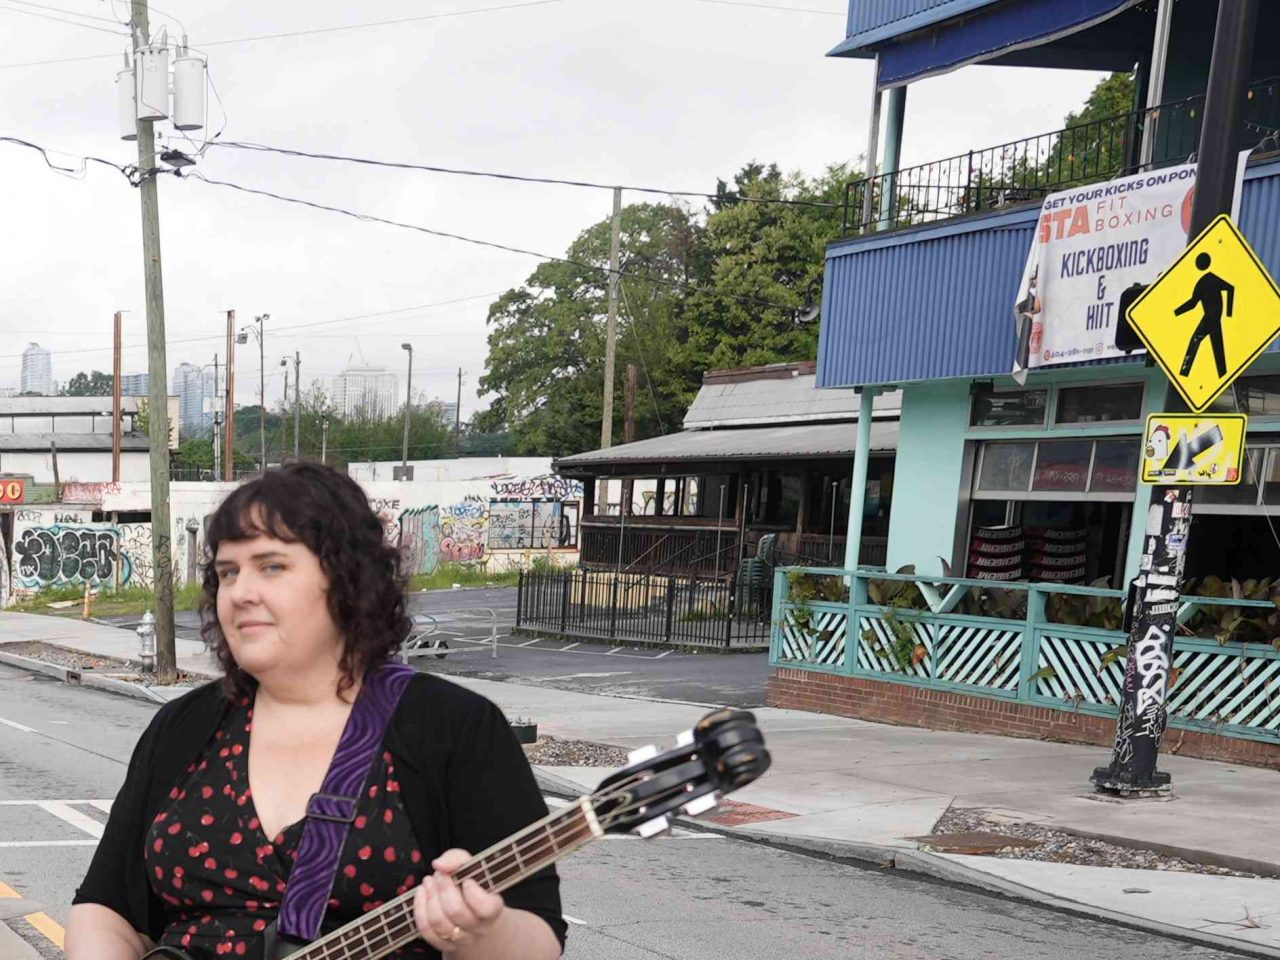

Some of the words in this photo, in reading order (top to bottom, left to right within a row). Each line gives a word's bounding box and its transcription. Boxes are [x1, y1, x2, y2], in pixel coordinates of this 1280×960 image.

[1044, 197, 1066, 210] GET
[1068, 189, 1103, 205] YOUR
[1104, 179, 1144, 197] KICKS
[1146, 174, 1167, 187] ON
[1168, 168, 1197, 184] PON
[1095, 204, 1173, 232] BOXING
[1096, 196, 1128, 214] FIT
[1061, 238, 1149, 279] KICKBOXING
[1097, 275, 1107, 300] &
[1086, 302, 1114, 331] HIIT
